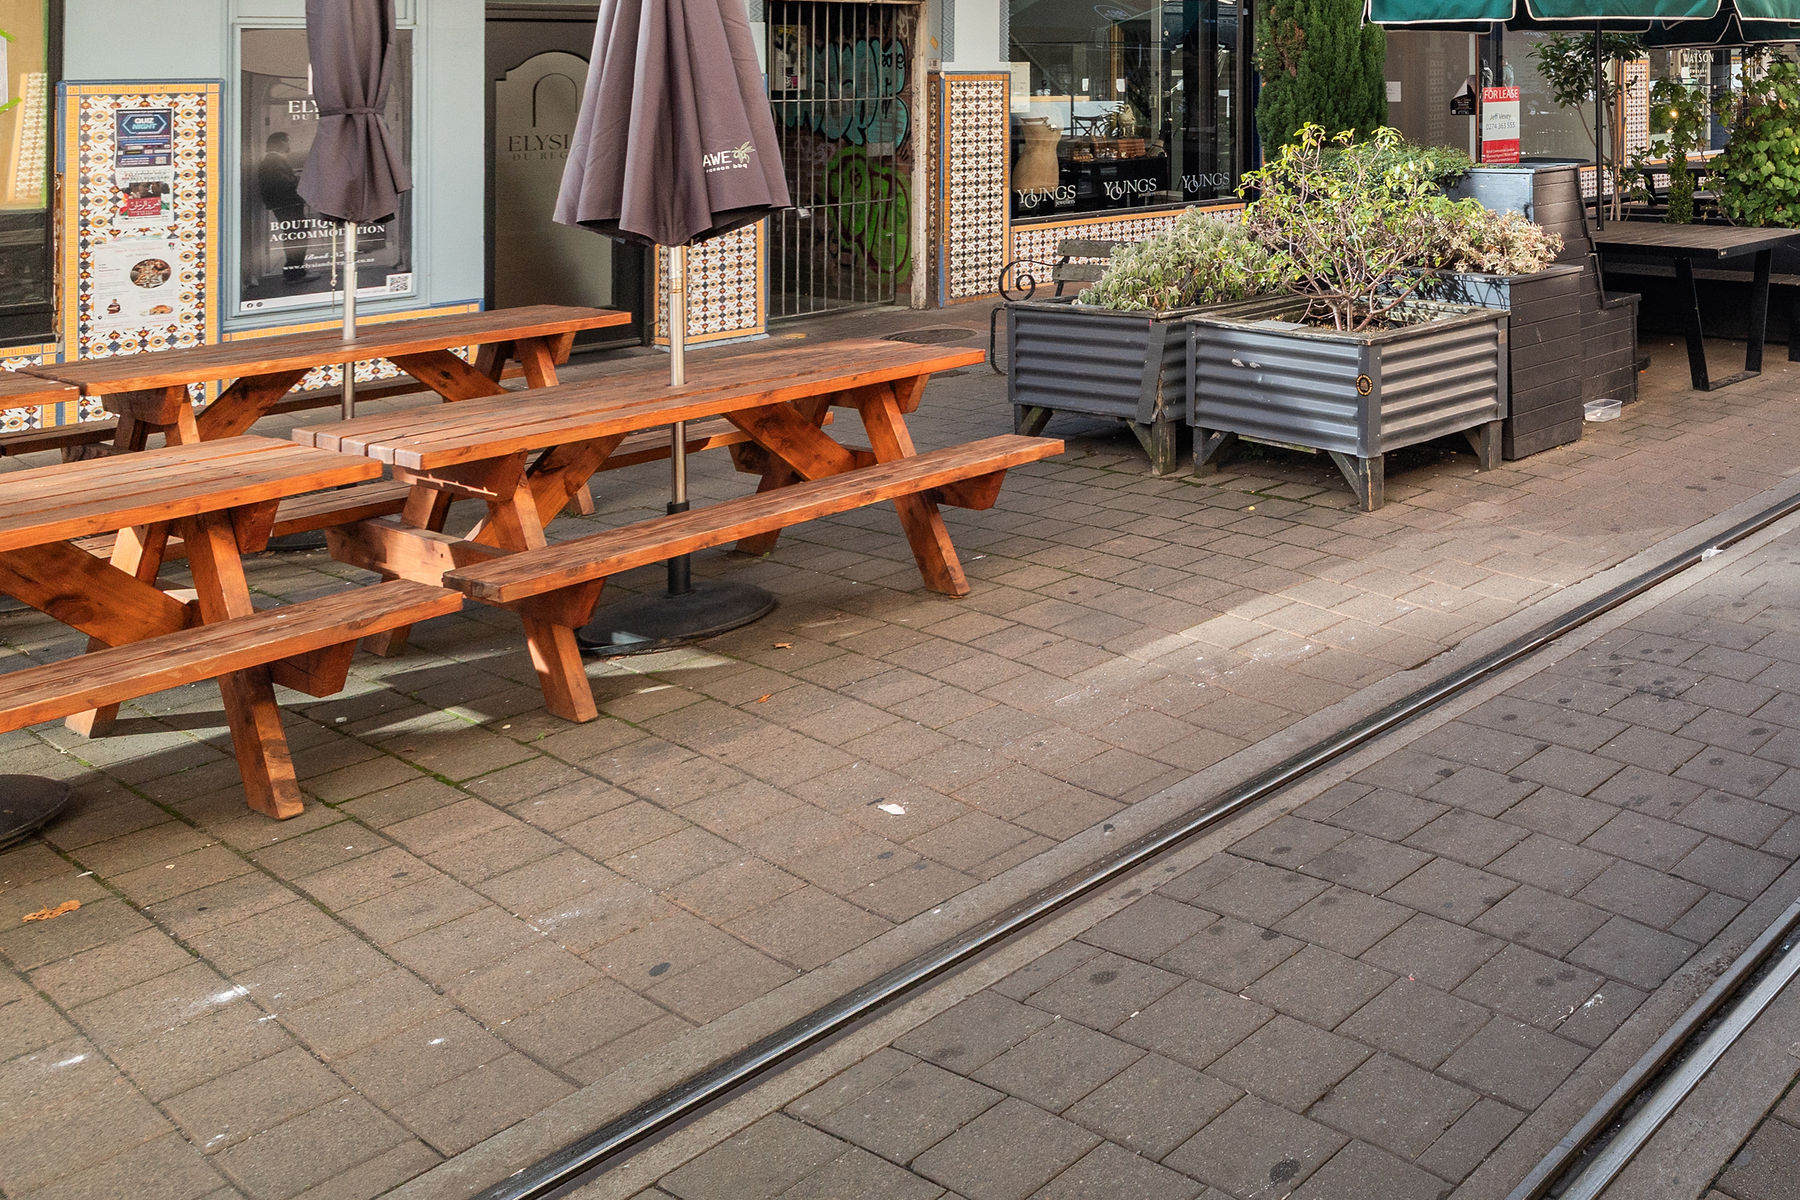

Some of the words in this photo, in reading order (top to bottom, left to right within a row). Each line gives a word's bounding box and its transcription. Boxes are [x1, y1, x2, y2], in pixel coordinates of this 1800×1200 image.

[1484, 89, 1498, 99] FOR
[1499, 88, 1518, 99] LEASE
[508, 133, 569, 152] ELYSI
[1104, 178, 1157, 200] YOUNGS
[1182, 172, 1231, 193] YOUNGS
[1017, 185, 1077, 208] YOUNGS
[270, 218, 336, 232] BOUTIQ
[270, 224, 385, 242] ACCOMMODTION
